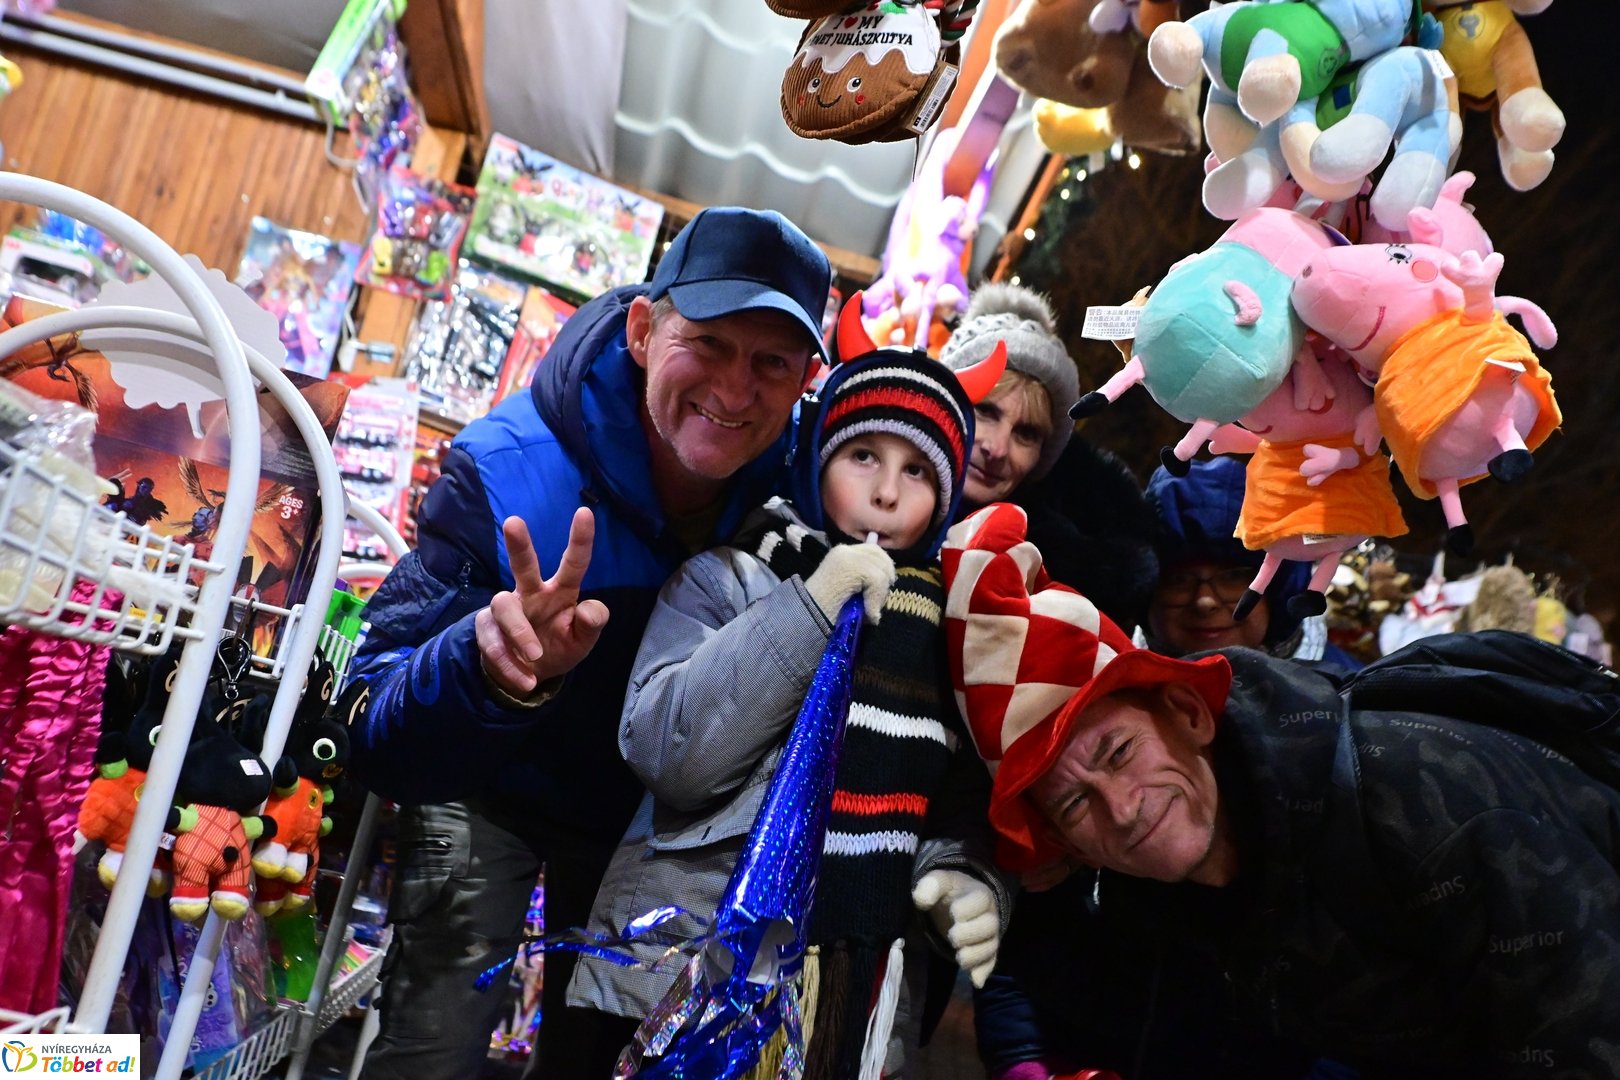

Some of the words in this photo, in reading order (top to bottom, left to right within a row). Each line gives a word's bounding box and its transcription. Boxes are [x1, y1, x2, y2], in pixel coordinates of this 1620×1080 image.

[858, 15, 884, 29] MY
[279, 495, 303, 508] AGES
[1488, 930, 1564, 957] Superior
